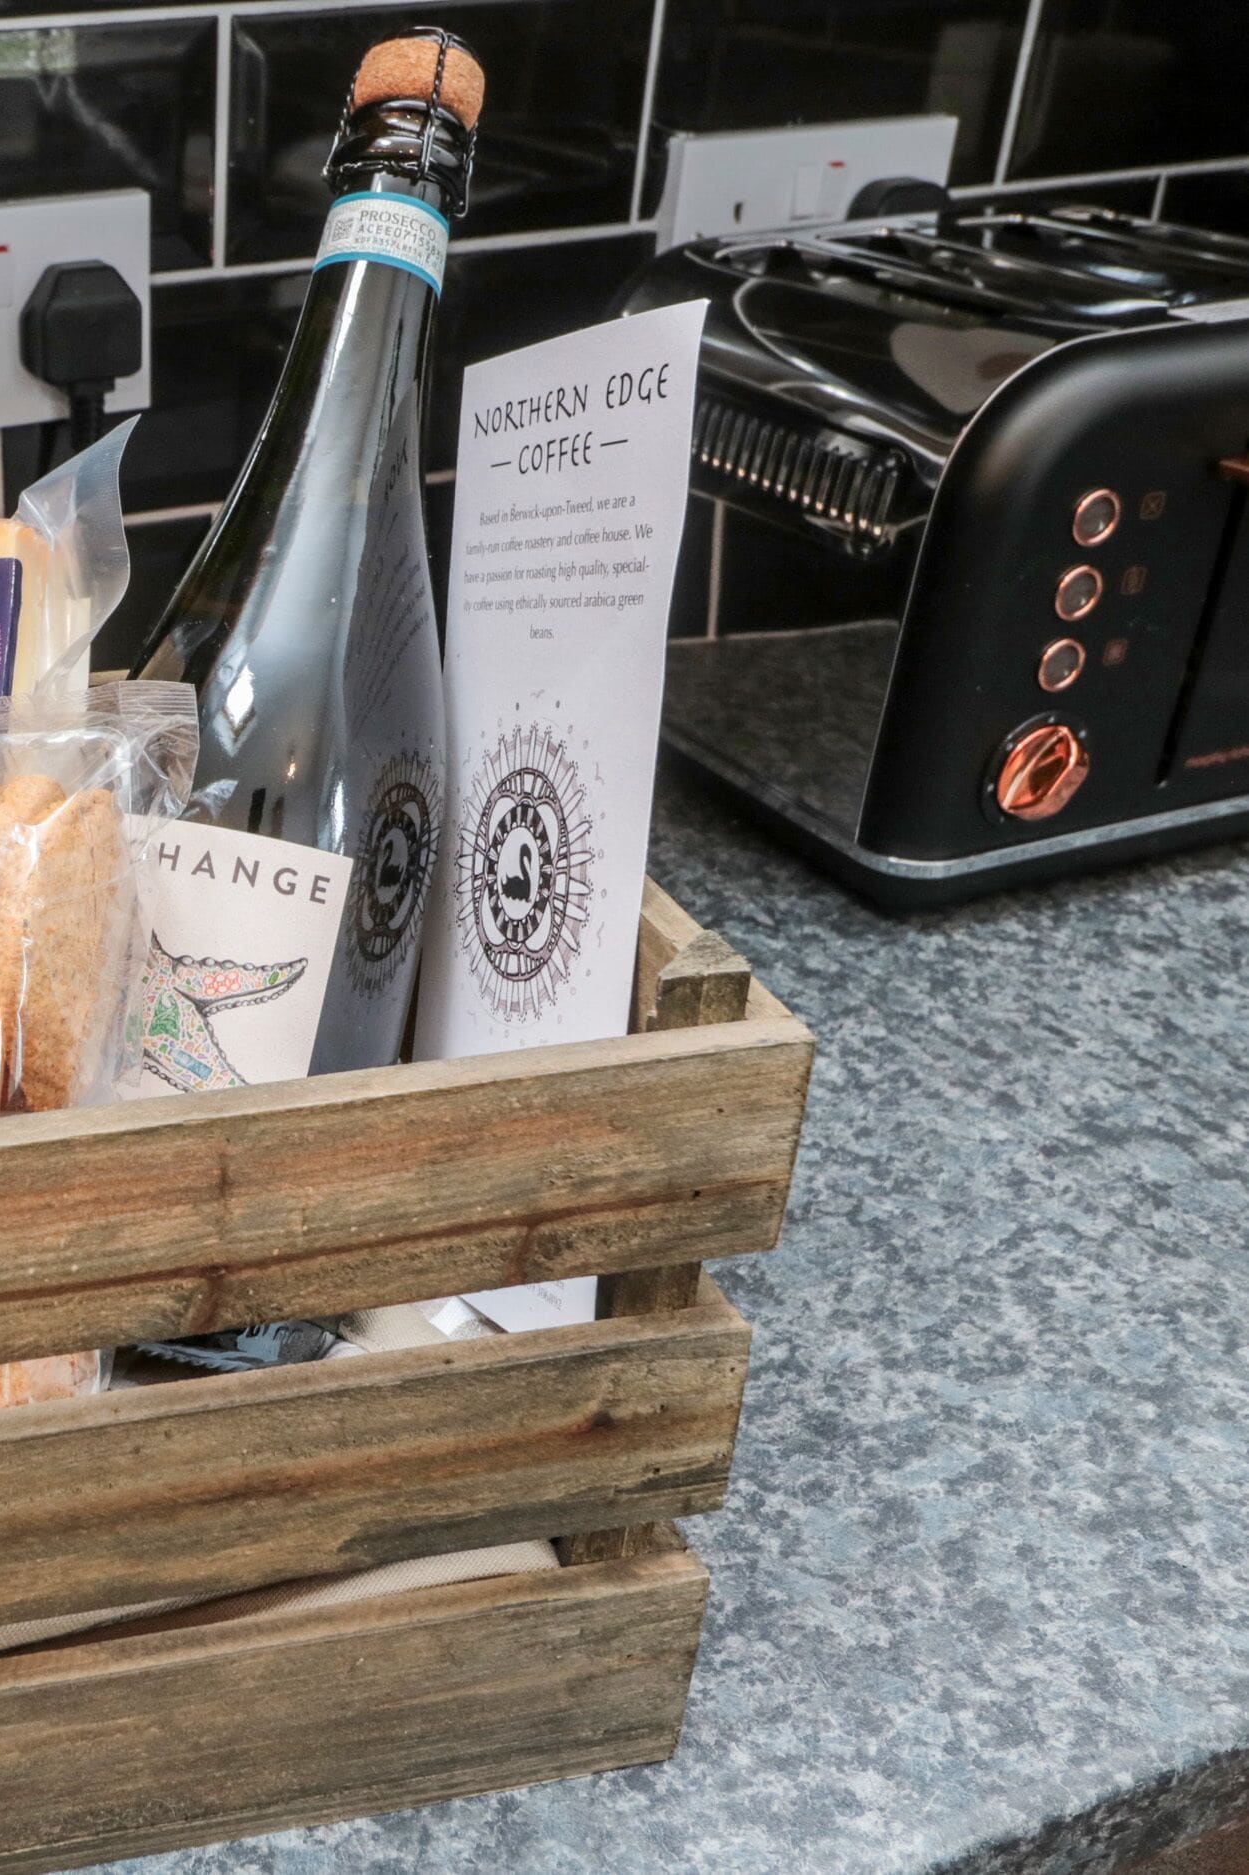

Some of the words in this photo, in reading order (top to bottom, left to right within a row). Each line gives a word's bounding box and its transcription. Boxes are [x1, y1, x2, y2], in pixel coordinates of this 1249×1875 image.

[360, 210, 436, 241] PROSECCO
[473, 384, 588, 439] NORTHERN
[606, 363, 669, 410] EDGE
[518, 431, 593, 475] COFFEE
[510, 496, 594, 522] Berwick-upon-Tweed,
[597, 498, 609, 510] we
[612, 497, 625, 509] are
[628, 496, 636, 507] a
[525, 536, 554, 552] roastery
[556, 531, 572, 547] and
[574, 529, 600, 545] coffee
[602, 525, 631, 543] house.
[635, 524, 653, 540] We
[526, 564, 556, 583] roasting
[558, 561, 576, 582] high
[495, 597, 514, 614] using
[515, 594, 547, 613] ethically
[549, 593, 581, 608] sourced
[584, 591, 615, 608] arabica
[618, 594, 644, 611] green
[529, 625, 554, 640] beans.
[158, 842, 331, 905] HANGE
